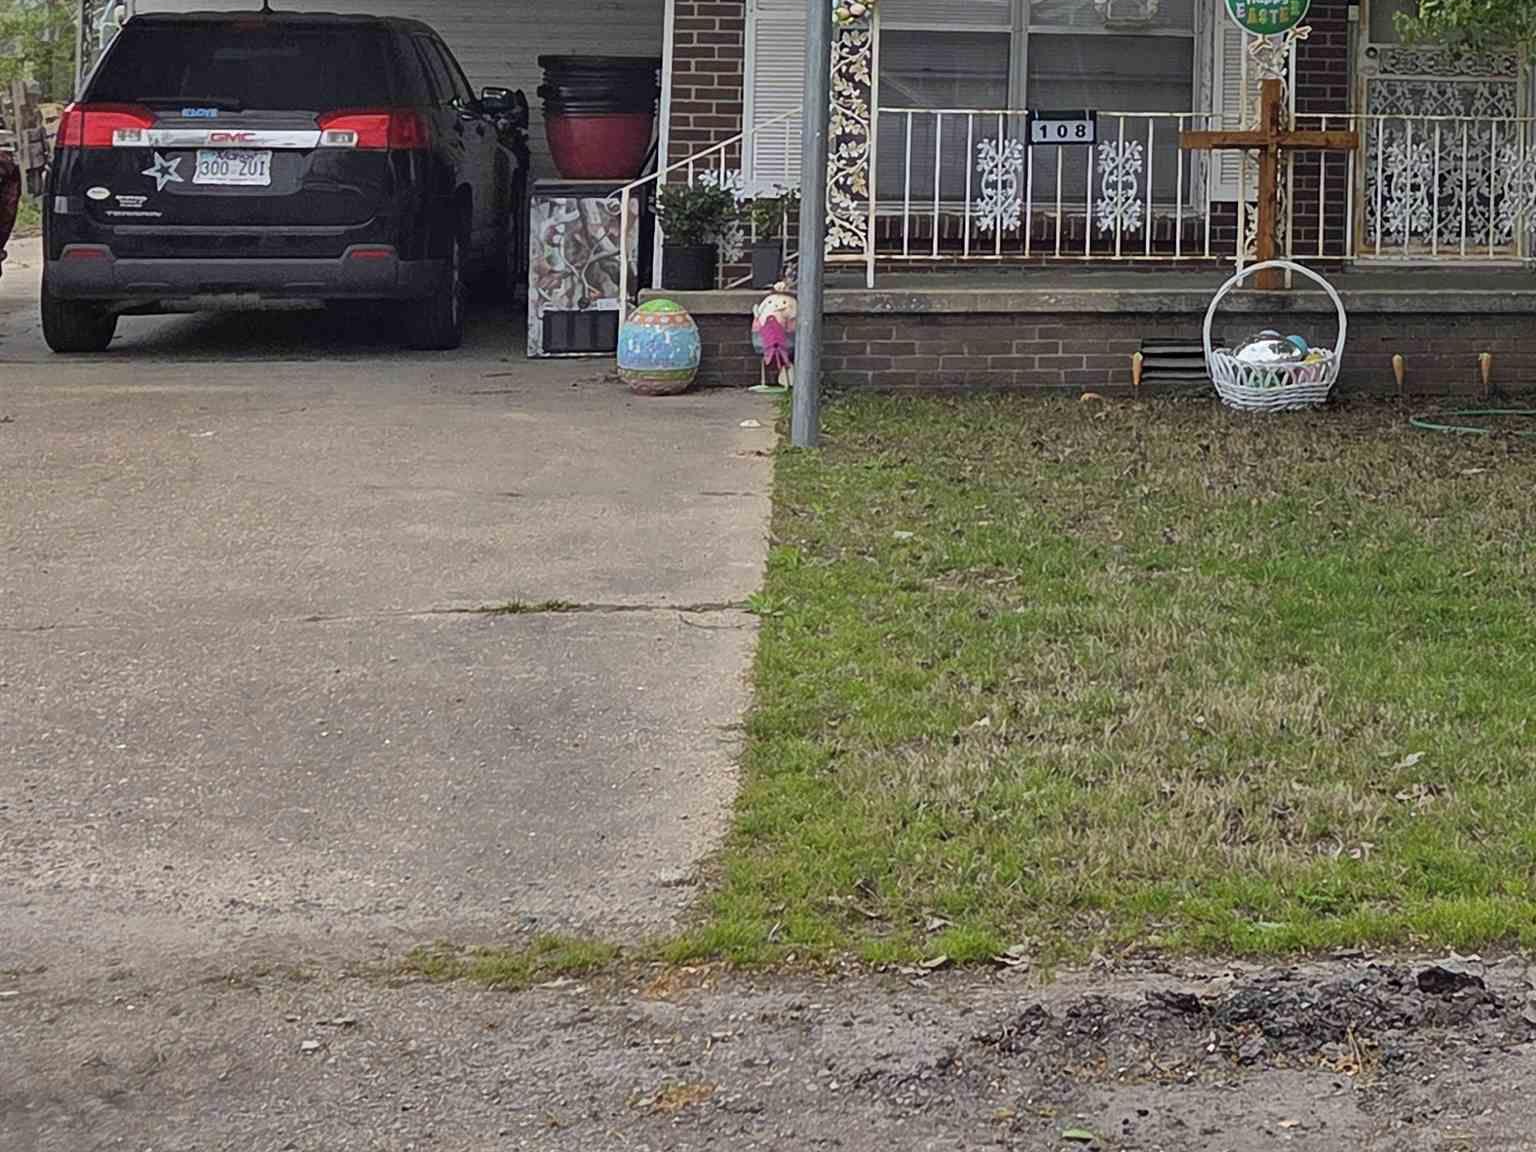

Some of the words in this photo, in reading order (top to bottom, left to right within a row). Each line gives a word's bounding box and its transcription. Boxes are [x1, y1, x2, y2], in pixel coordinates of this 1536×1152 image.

[210, 132, 257, 143] GMC
[1039, 124, 1086, 139] 108
[200, 160, 230, 176] 300
